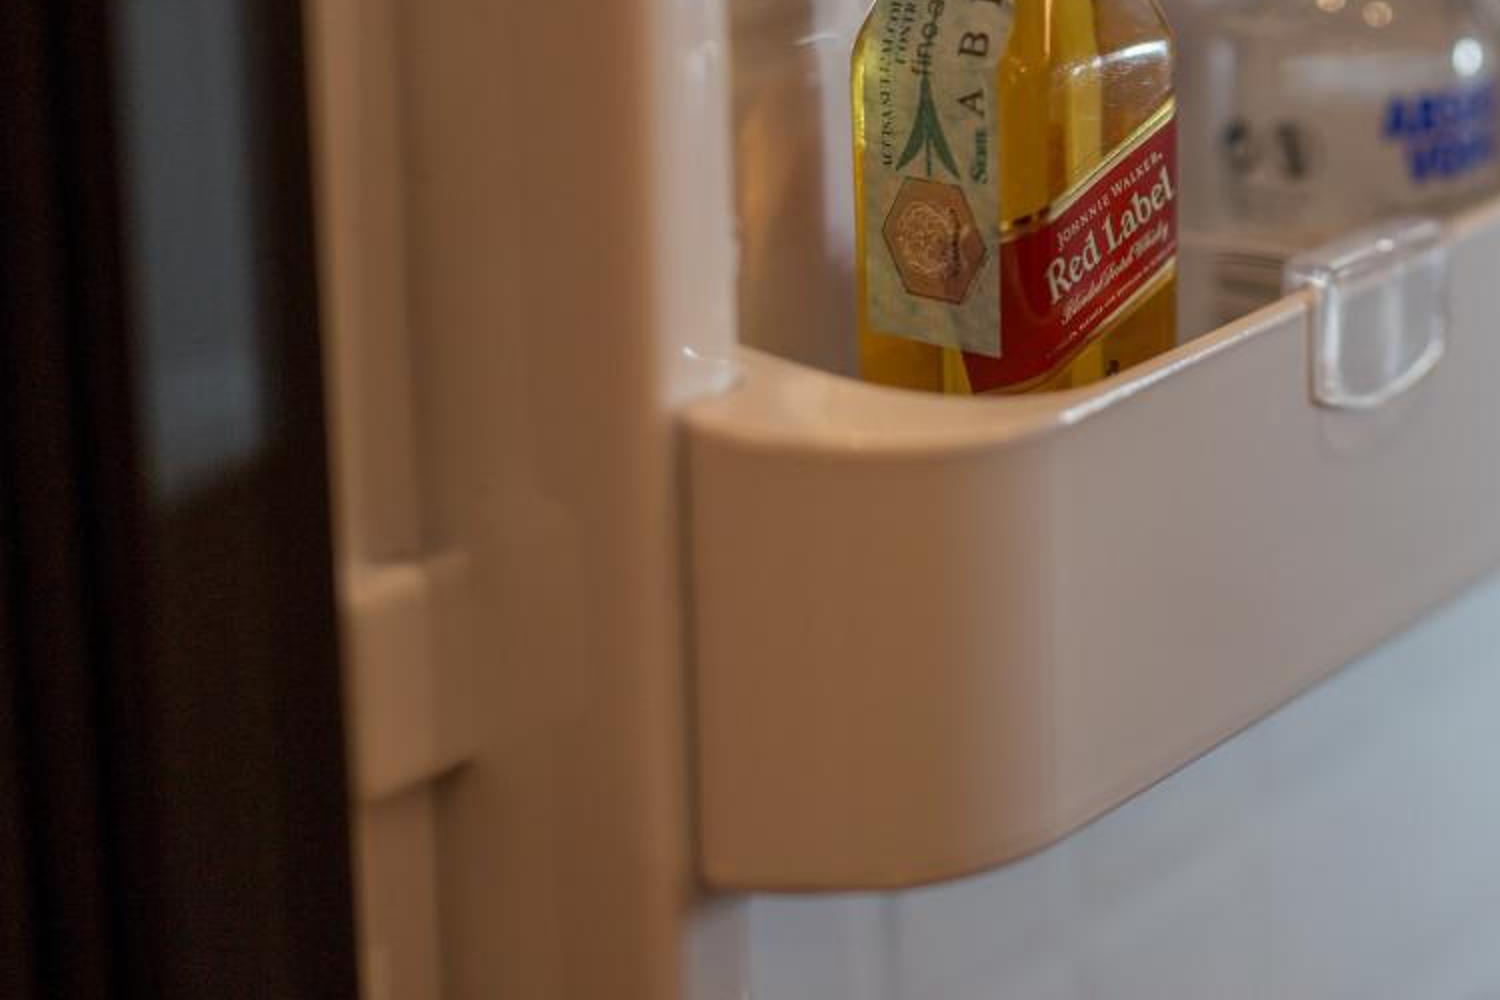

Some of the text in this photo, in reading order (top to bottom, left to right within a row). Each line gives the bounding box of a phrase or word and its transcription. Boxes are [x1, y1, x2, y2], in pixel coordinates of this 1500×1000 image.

[958, 30, 990, 57] B
[957, 89, 984, 116] A
[1046, 229, 1103, 303] Red
[1101, 166, 1174, 251] Label
